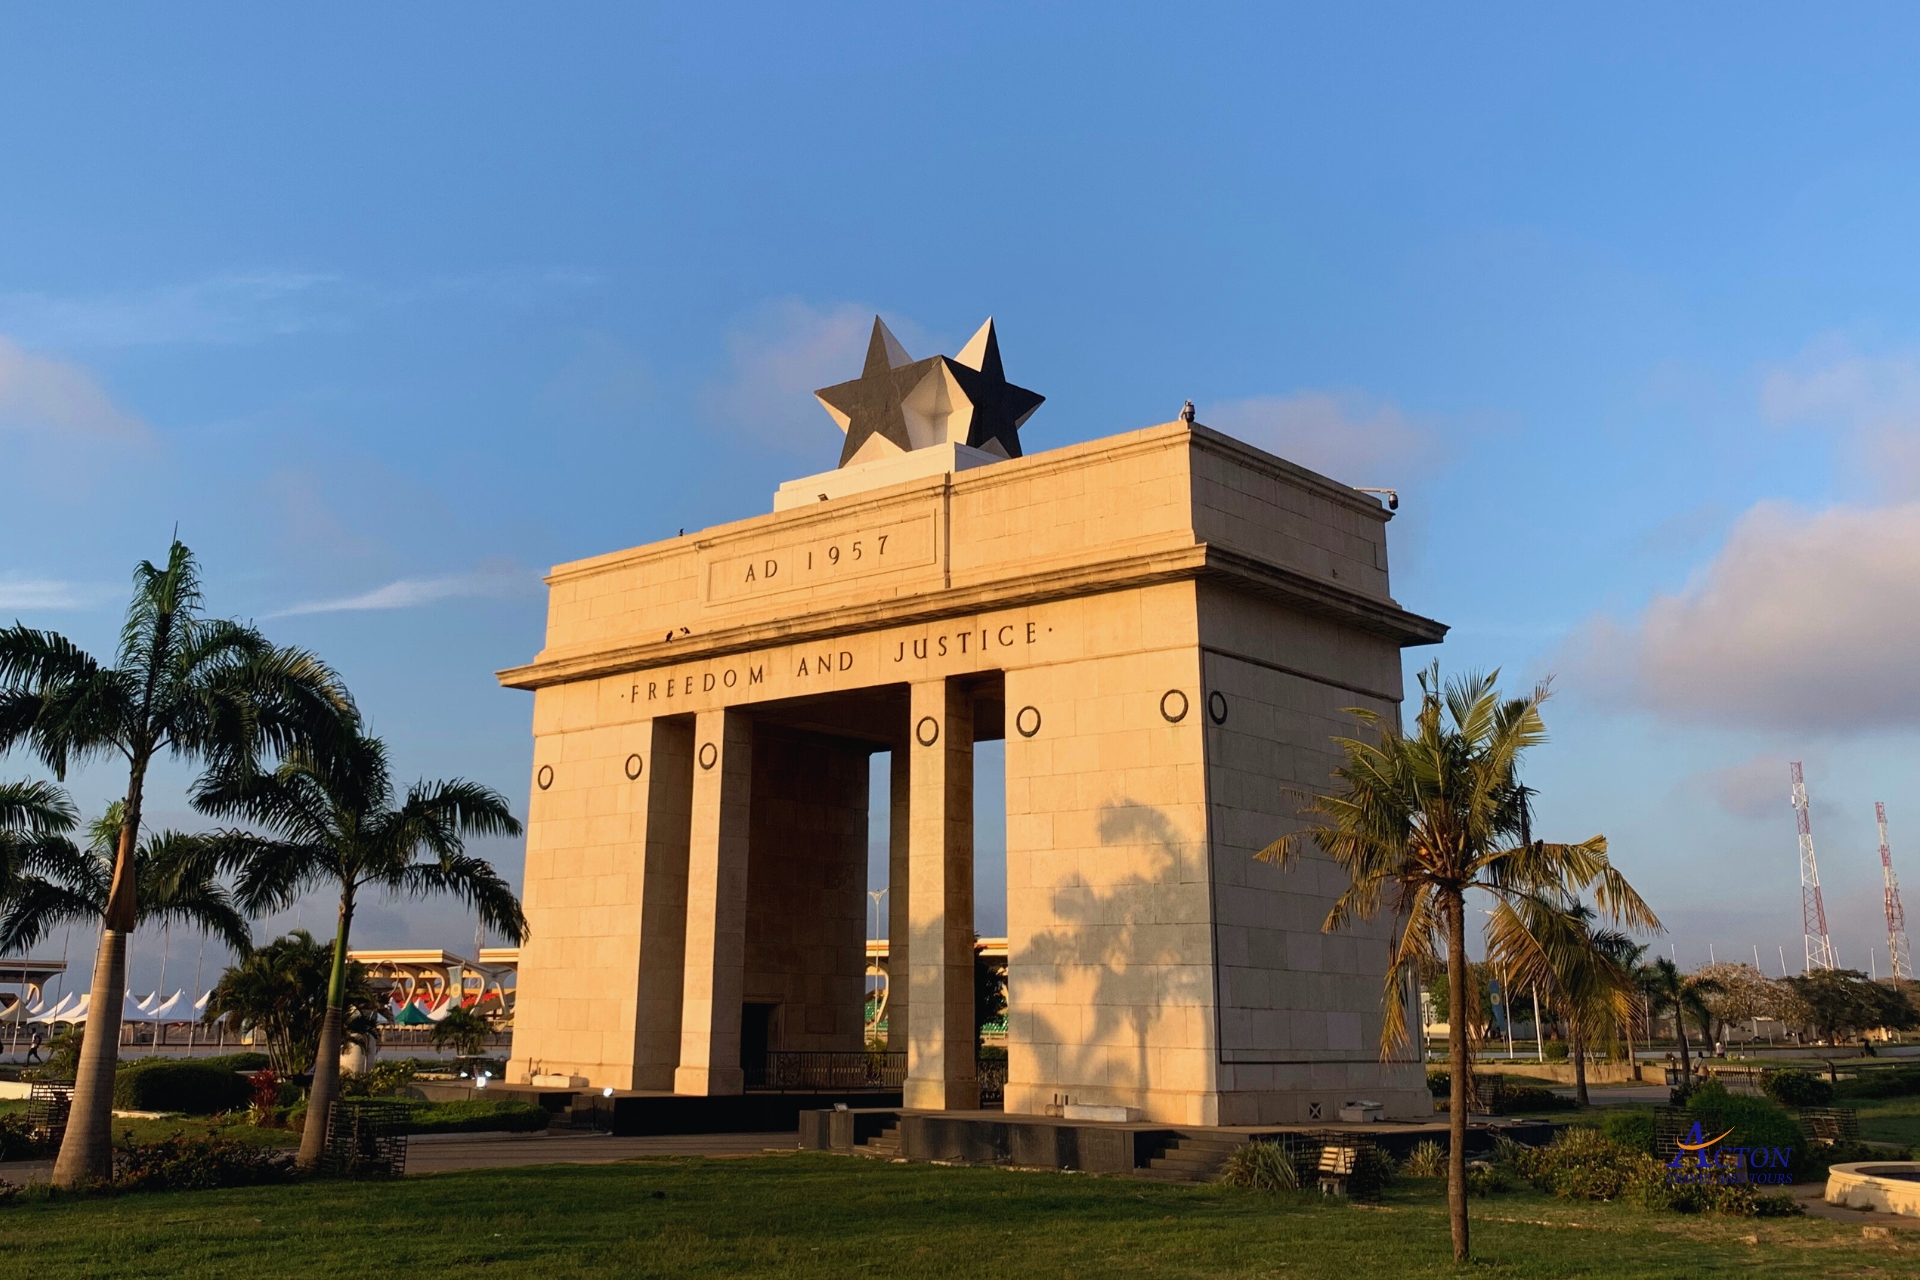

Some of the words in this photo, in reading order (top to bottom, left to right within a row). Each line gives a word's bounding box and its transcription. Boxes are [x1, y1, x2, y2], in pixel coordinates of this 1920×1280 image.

[745, 559, 778, 582] AD
[807, 534, 889, 570] 1957
[797, 651, 854, 677] AND
